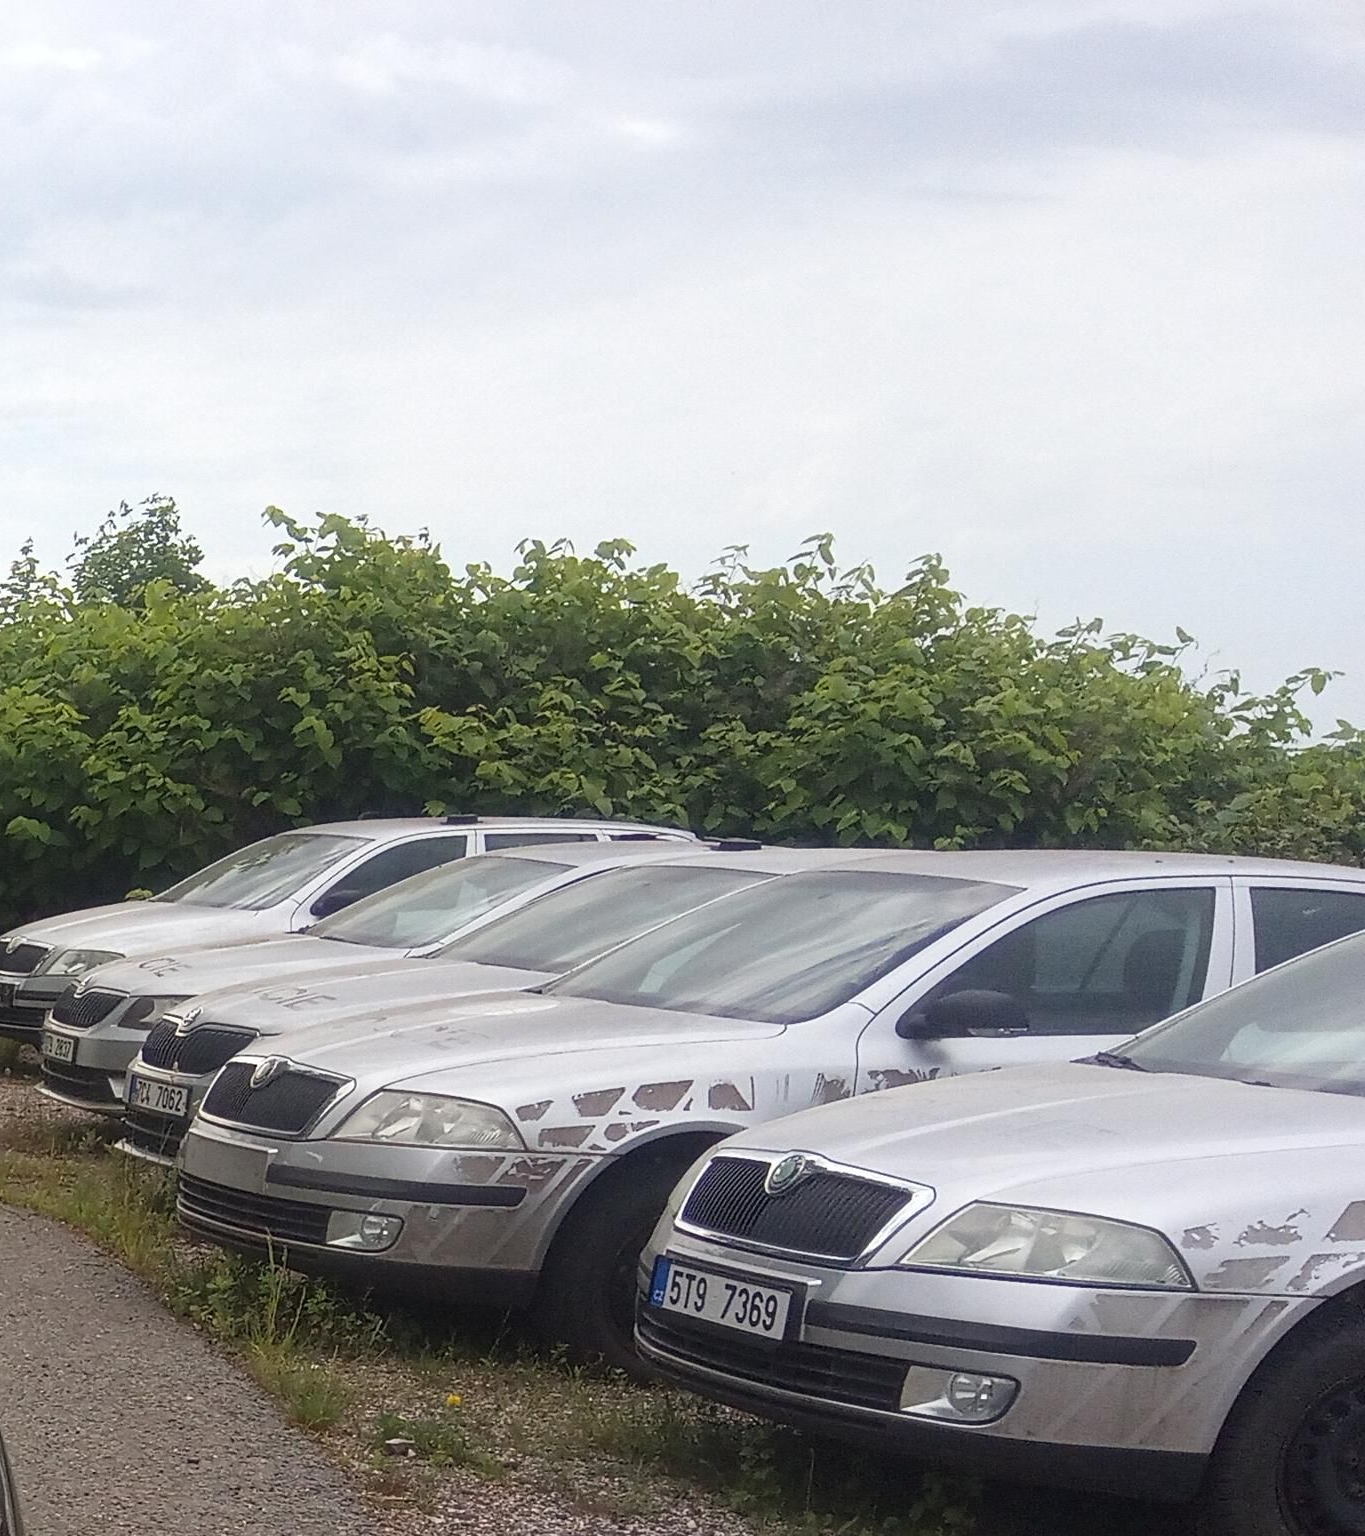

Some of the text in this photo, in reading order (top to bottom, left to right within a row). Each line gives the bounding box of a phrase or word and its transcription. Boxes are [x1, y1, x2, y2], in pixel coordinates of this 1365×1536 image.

[155, 1085, 183, 1112] 7062
[668, 1269, 708, 1313] 5T9
[719, 1283, 779, 1332] 7369
